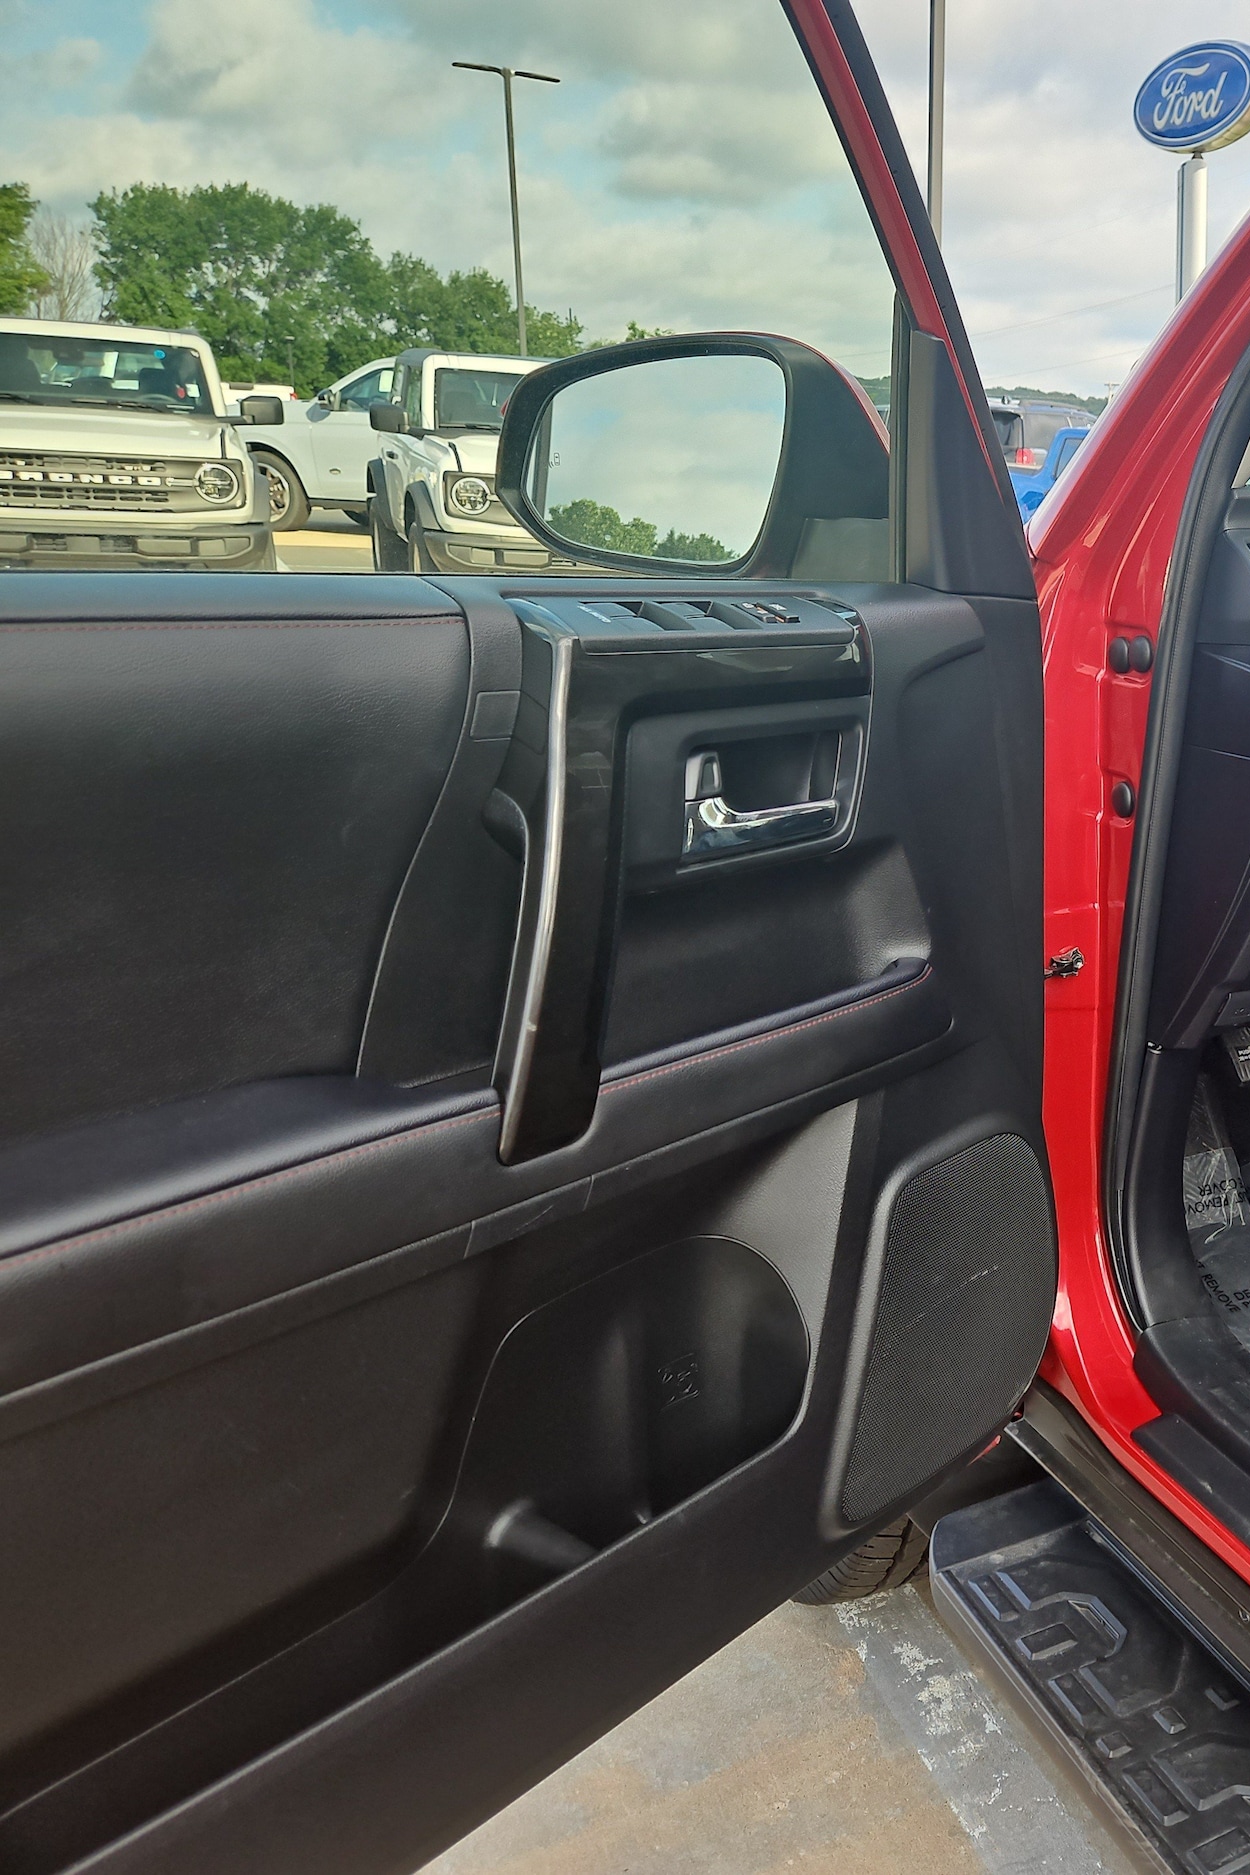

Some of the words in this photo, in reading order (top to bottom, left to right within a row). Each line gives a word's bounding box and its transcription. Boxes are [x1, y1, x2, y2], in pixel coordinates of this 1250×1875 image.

[1153, 63, 1228, 130] Ford
[1187, 1195, 1229, 1214] REMOV
[1201, 1273, 1242, 1313] REMOVE
